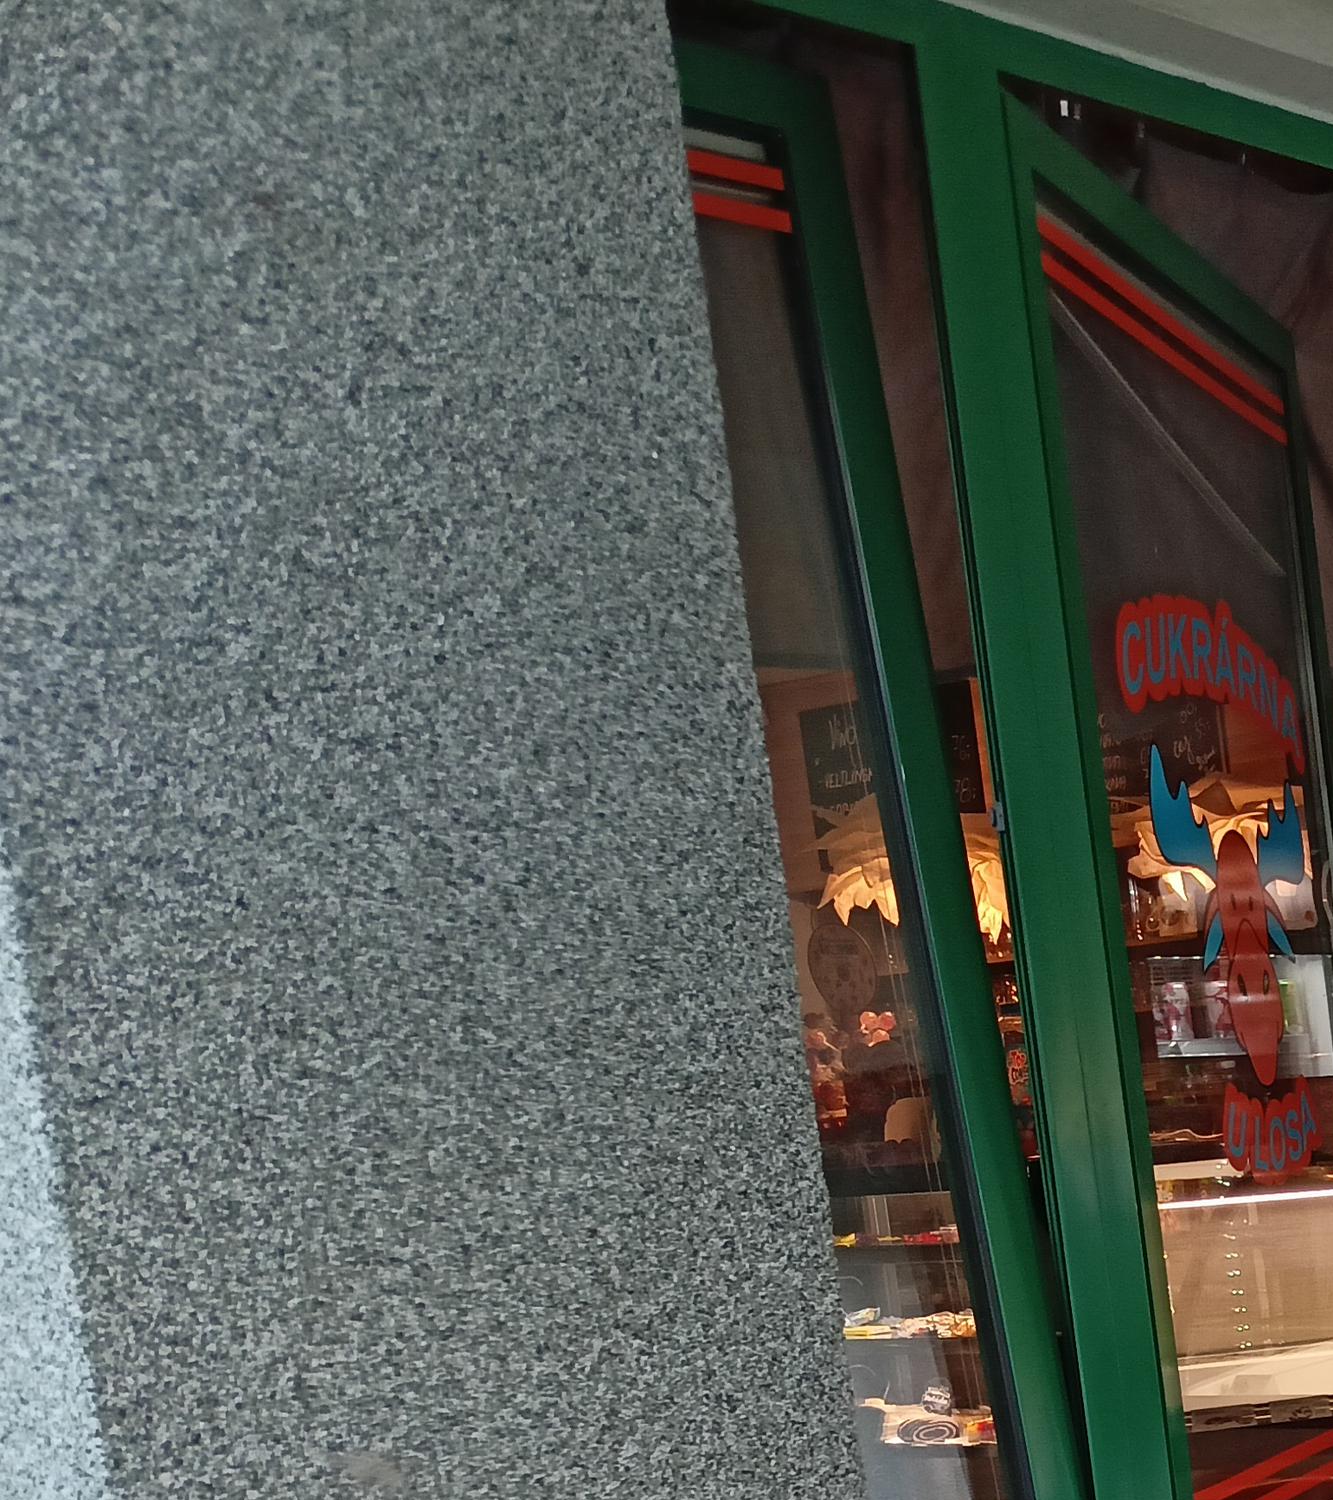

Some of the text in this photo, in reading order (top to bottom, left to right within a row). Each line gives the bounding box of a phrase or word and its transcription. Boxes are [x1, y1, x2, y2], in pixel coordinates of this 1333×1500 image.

[1121, 611, 1301, 758] CUKRÁRNA
[1227, 1089, 1317, 1172] U LOSA
